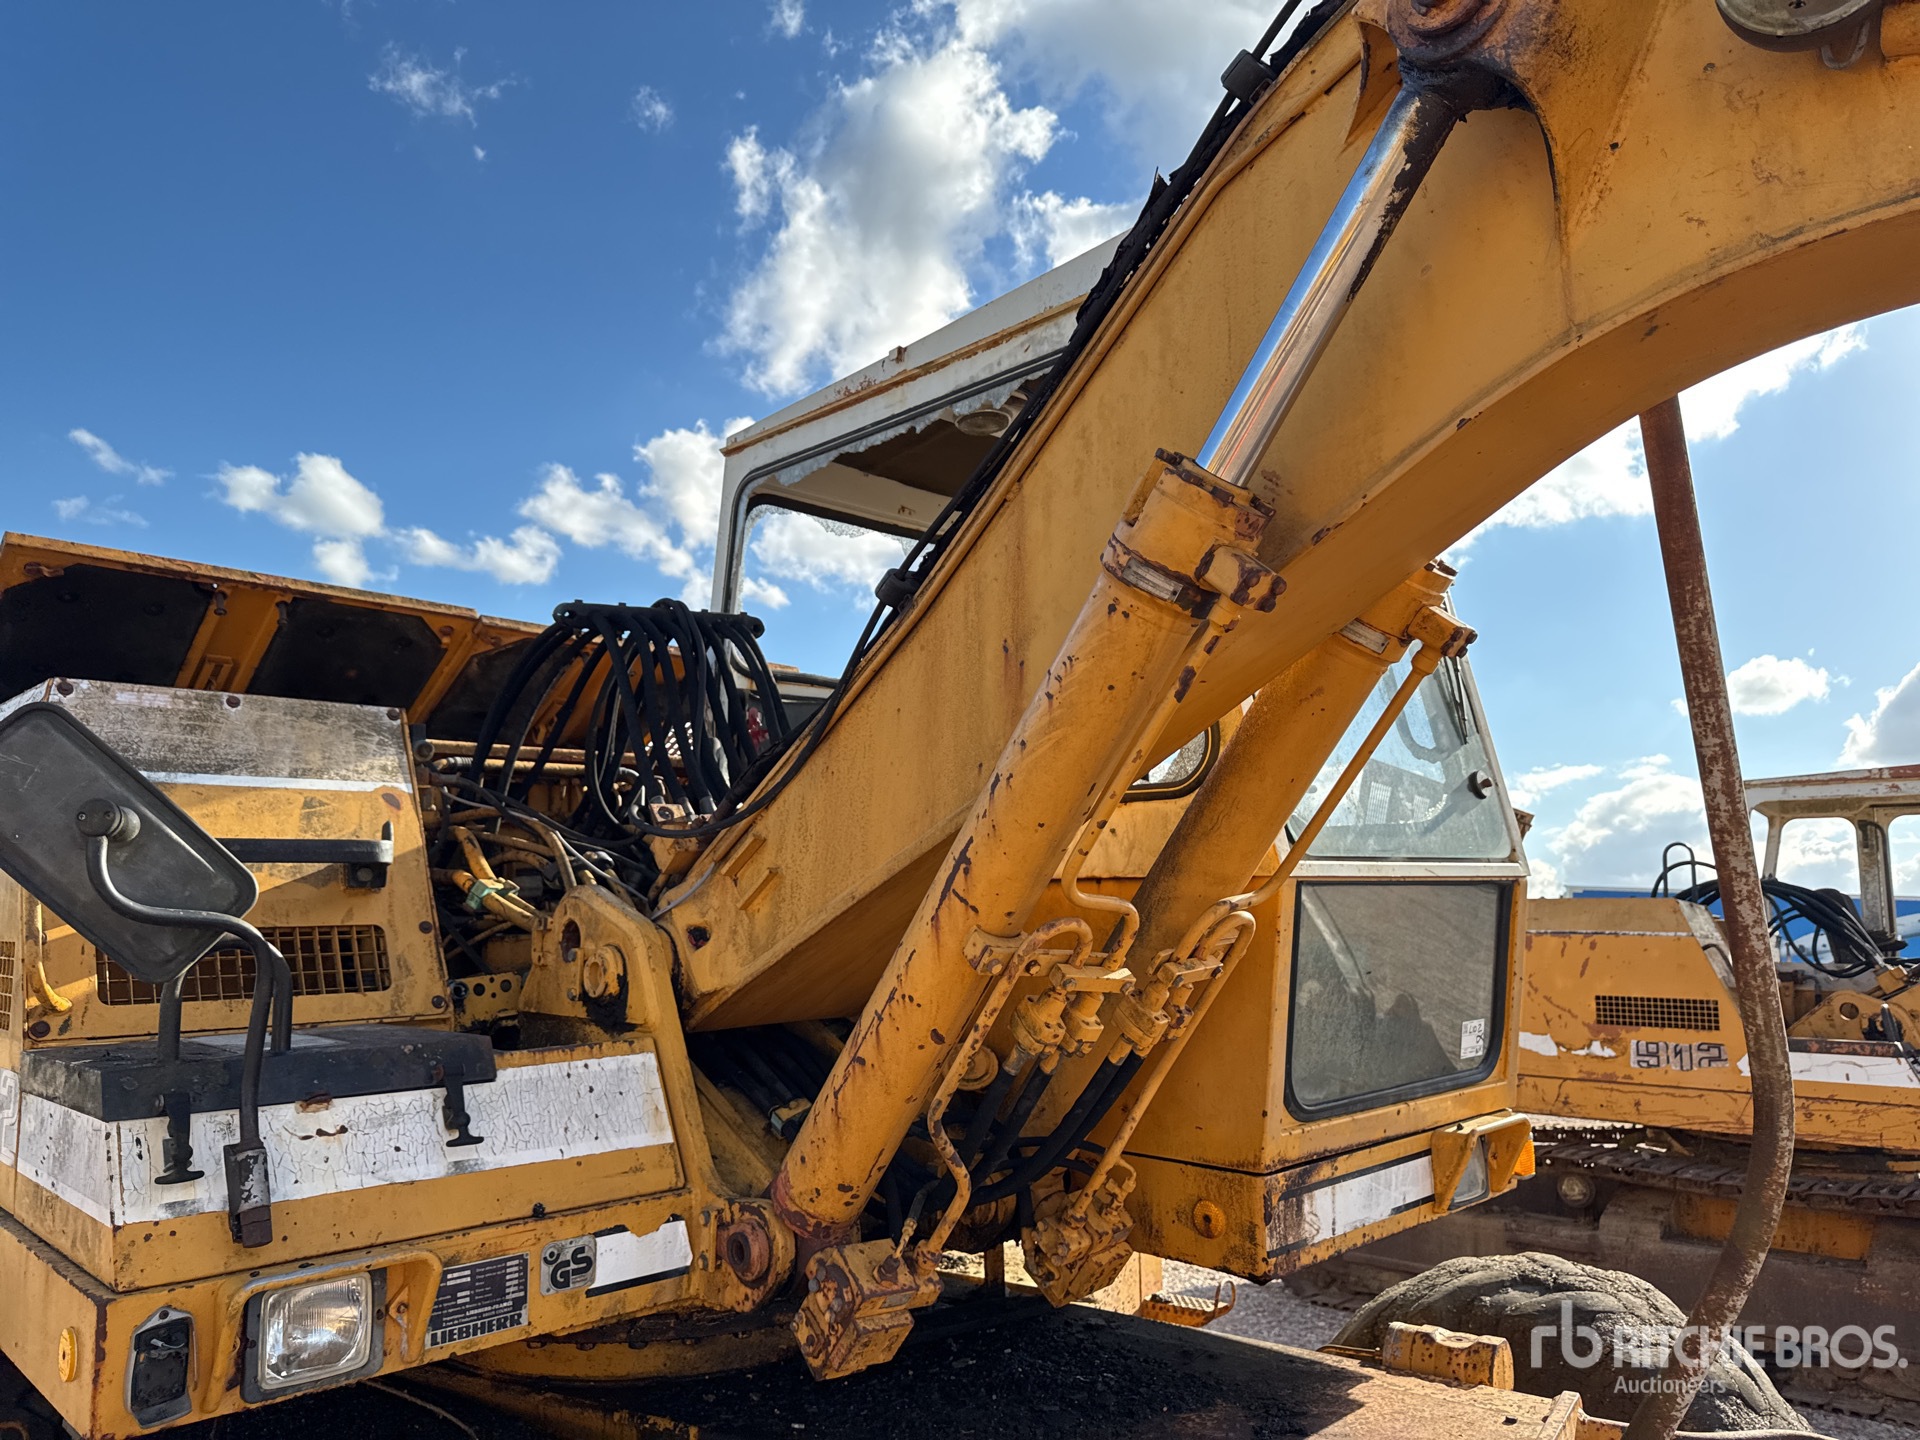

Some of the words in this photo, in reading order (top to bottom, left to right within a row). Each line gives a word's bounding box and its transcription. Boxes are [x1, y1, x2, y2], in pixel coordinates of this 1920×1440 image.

[1635, 1040, 1728, 1072] 912
[550, 1245, 593, 1289] GS
[430, 1312, 523, 1347] LIEBHERR
